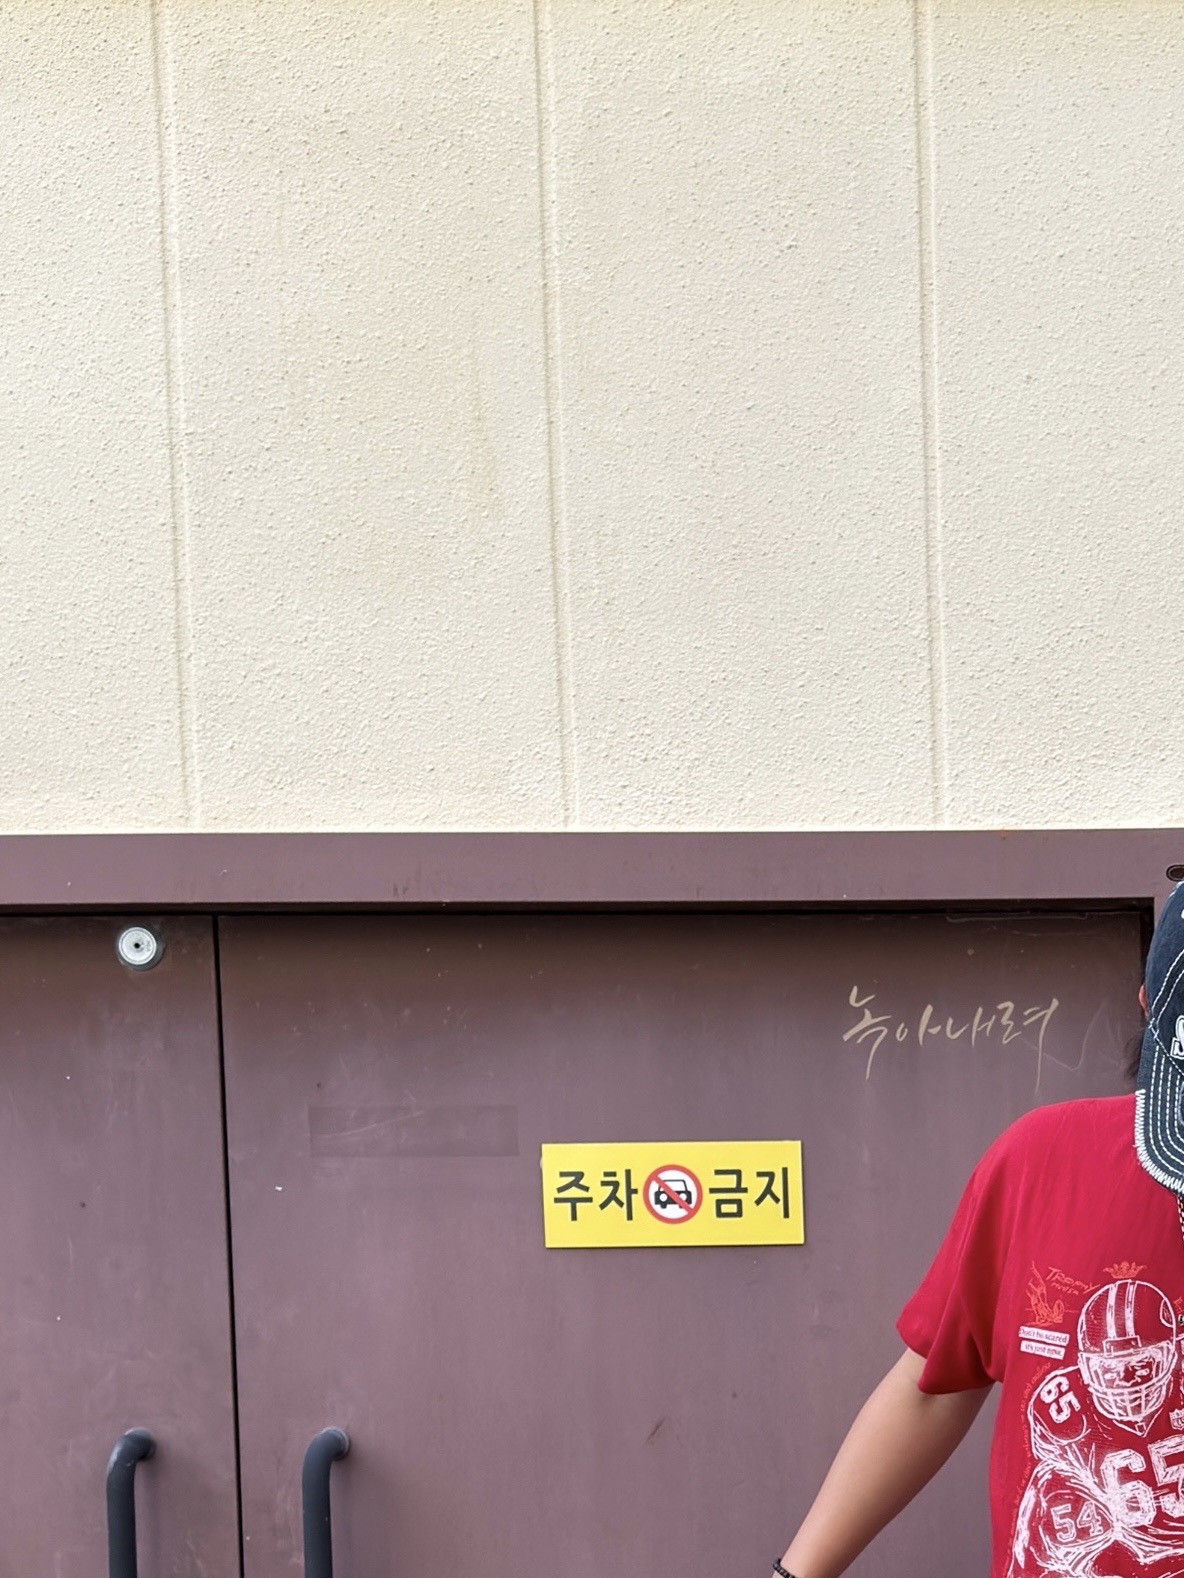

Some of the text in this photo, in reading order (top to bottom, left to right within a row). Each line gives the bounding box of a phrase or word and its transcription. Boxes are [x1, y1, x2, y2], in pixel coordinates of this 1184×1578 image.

[552, 1166, 791, 1222] 주차 금지
[1040, 1376, 1081, 1424] 65
[1050, 1501, 1104, 1543] 54
